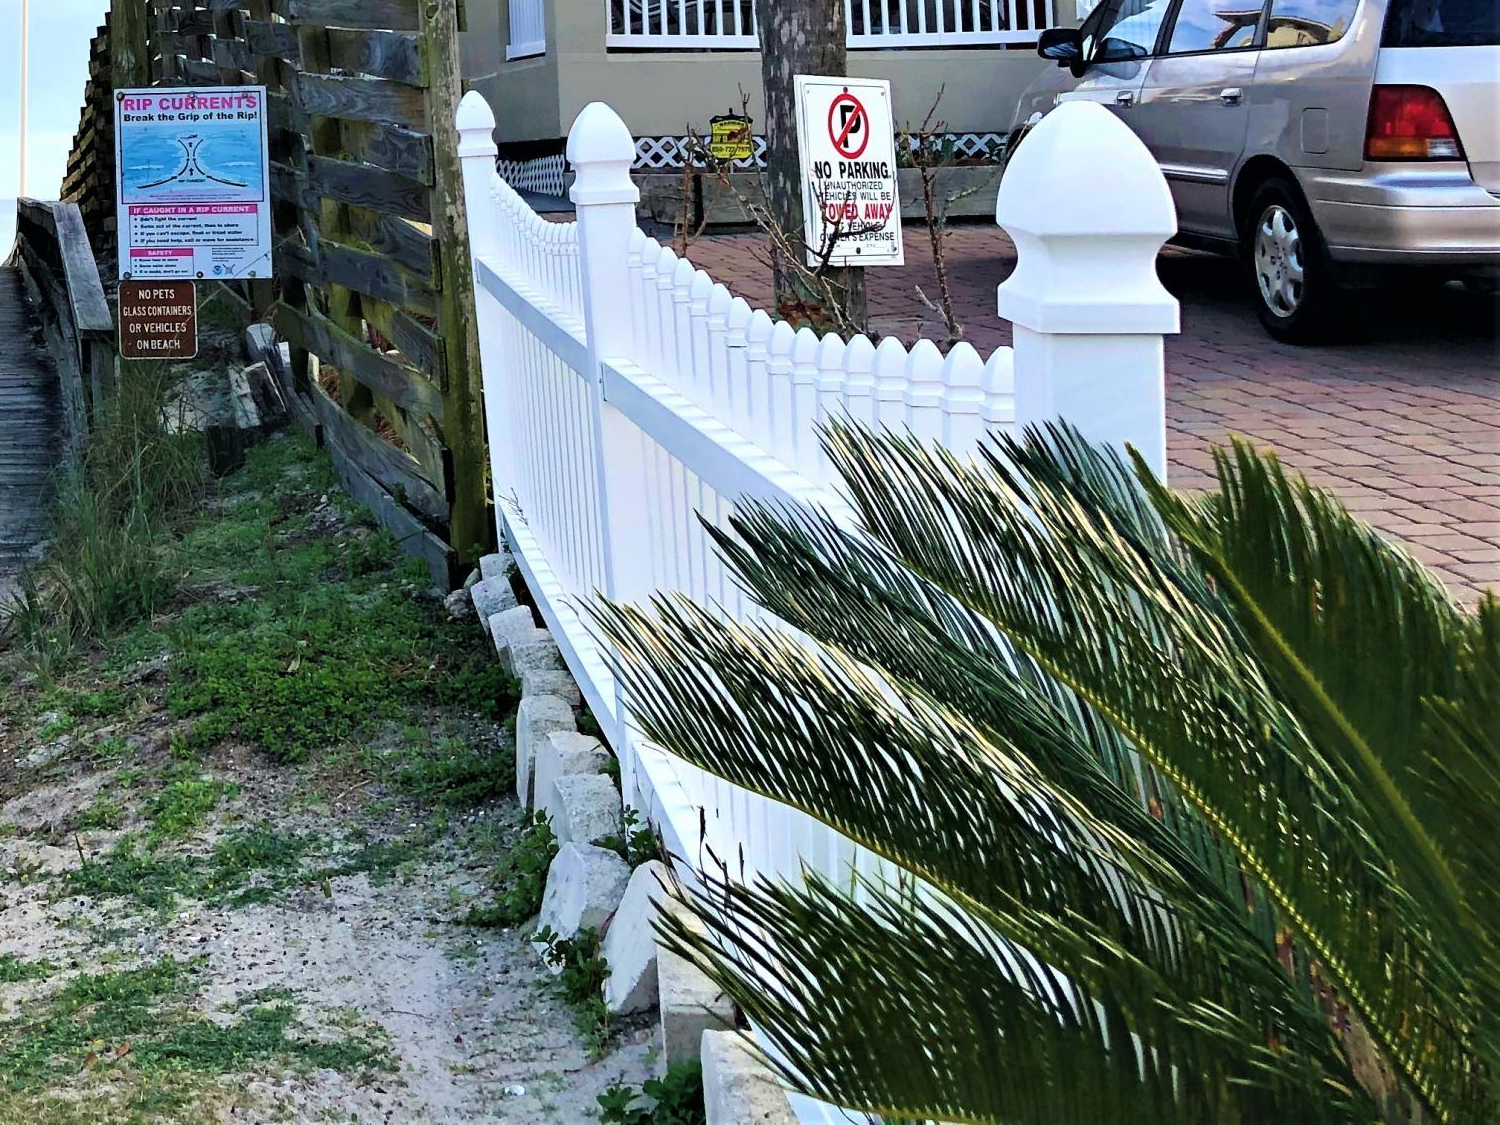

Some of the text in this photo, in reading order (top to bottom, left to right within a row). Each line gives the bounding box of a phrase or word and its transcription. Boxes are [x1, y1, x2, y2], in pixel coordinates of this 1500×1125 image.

[123, 96, 257, 111] RIP CURRENTS
[123, 111, 257, 122] Break the Grip of the Rip!
[814, 161, 889, 179] NO PARKING
[824, 181, 883, 190] UNAUTHORIZED
[860, 192, 878, 201] WILL
[880, 192, 891, 201] BE
[864, 203, 892, 220] AWAY
[860, 232, 894, 241] EXPENSE
[139, 289, 175, 299] NO PETS
[123, 305, 192, 316] GLASS CONTAINERS
[129, 322, 187, 333] OR VEHICLES
[136, 339, 180, 350] ON BEACH
